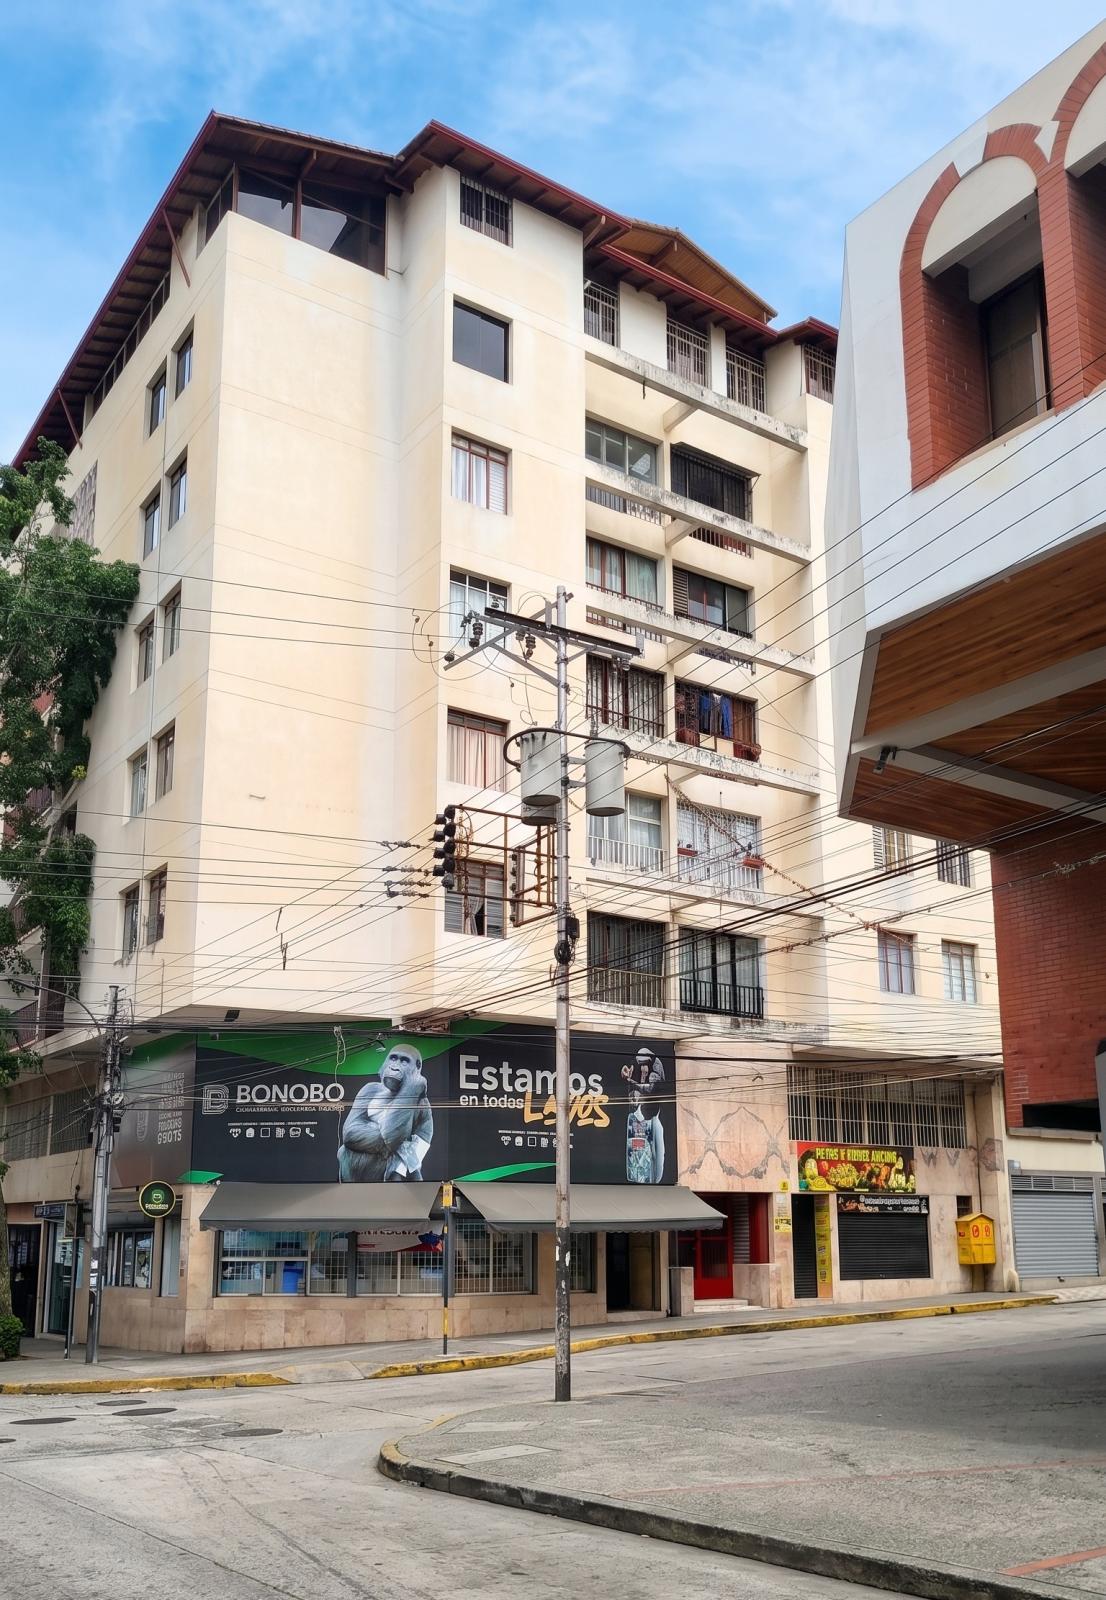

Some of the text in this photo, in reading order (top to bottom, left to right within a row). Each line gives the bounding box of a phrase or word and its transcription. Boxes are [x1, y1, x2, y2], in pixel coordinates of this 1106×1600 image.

[460, 1054, 604, 1096] Estamos
[236, 1083, 344, 1103] BONOBO
[460, 1095, 478, 1106] en
[483, 1094, 524, 1109] todas
